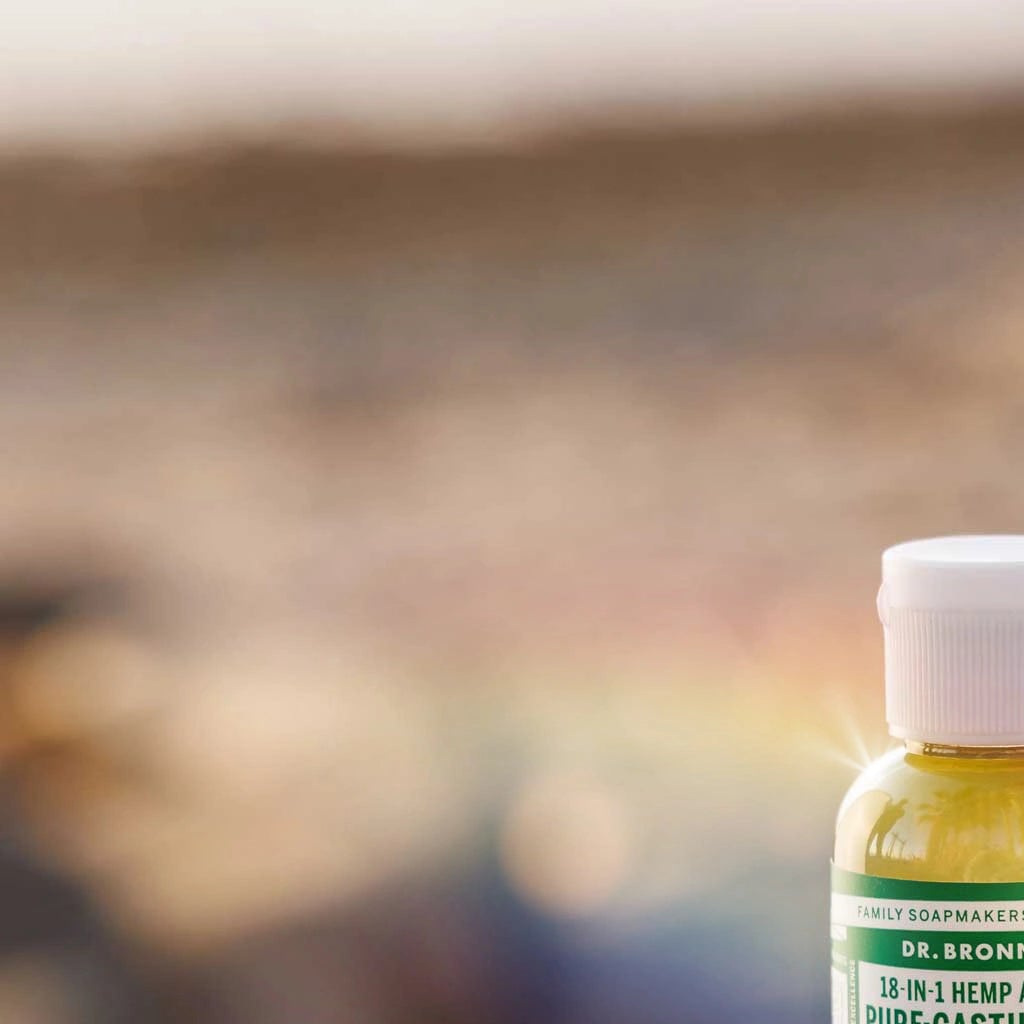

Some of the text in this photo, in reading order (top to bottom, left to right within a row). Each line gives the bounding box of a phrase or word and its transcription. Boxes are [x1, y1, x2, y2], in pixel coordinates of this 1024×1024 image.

[858, 905, 904, 921] FAMILY
[902, 940, 938, 959] DR.
[880, 976, 944, 1003] 18-IN-1
[952, 981, 1012, 1004] HEMP
